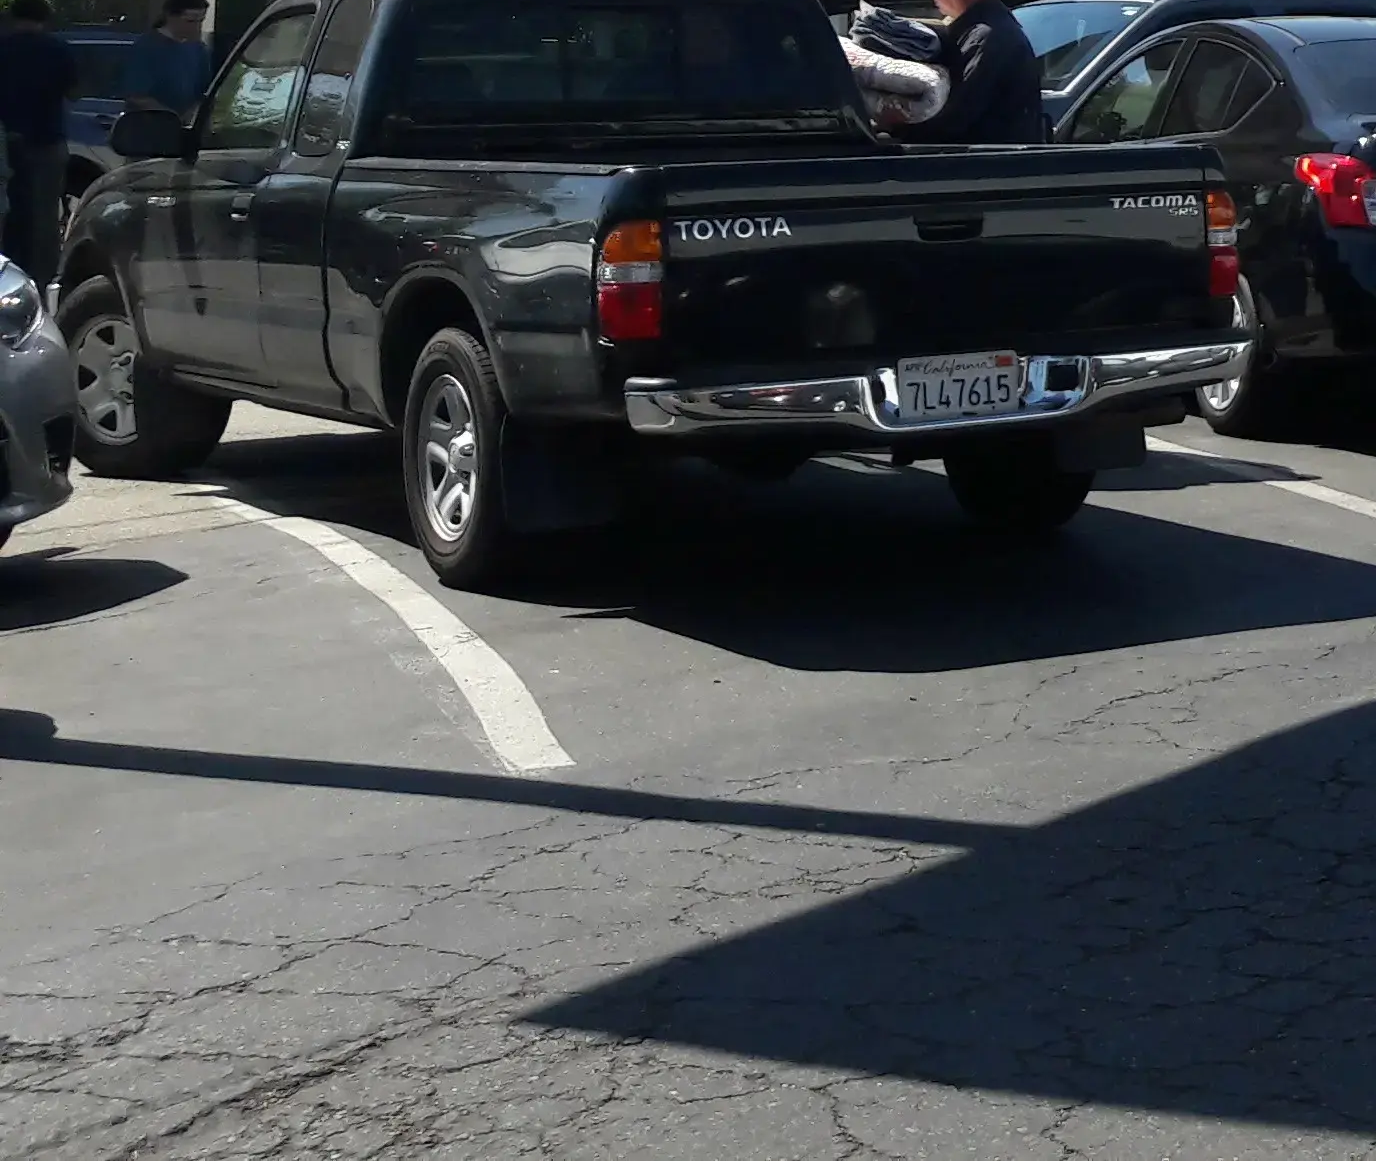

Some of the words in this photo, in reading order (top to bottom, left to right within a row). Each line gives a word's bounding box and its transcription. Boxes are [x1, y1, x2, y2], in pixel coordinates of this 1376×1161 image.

[1109, 195, 1197, 209] TACOMA
[673, 217, 792, 241] TOYOTA
[906, 374, 1010, 411] 7L47615
